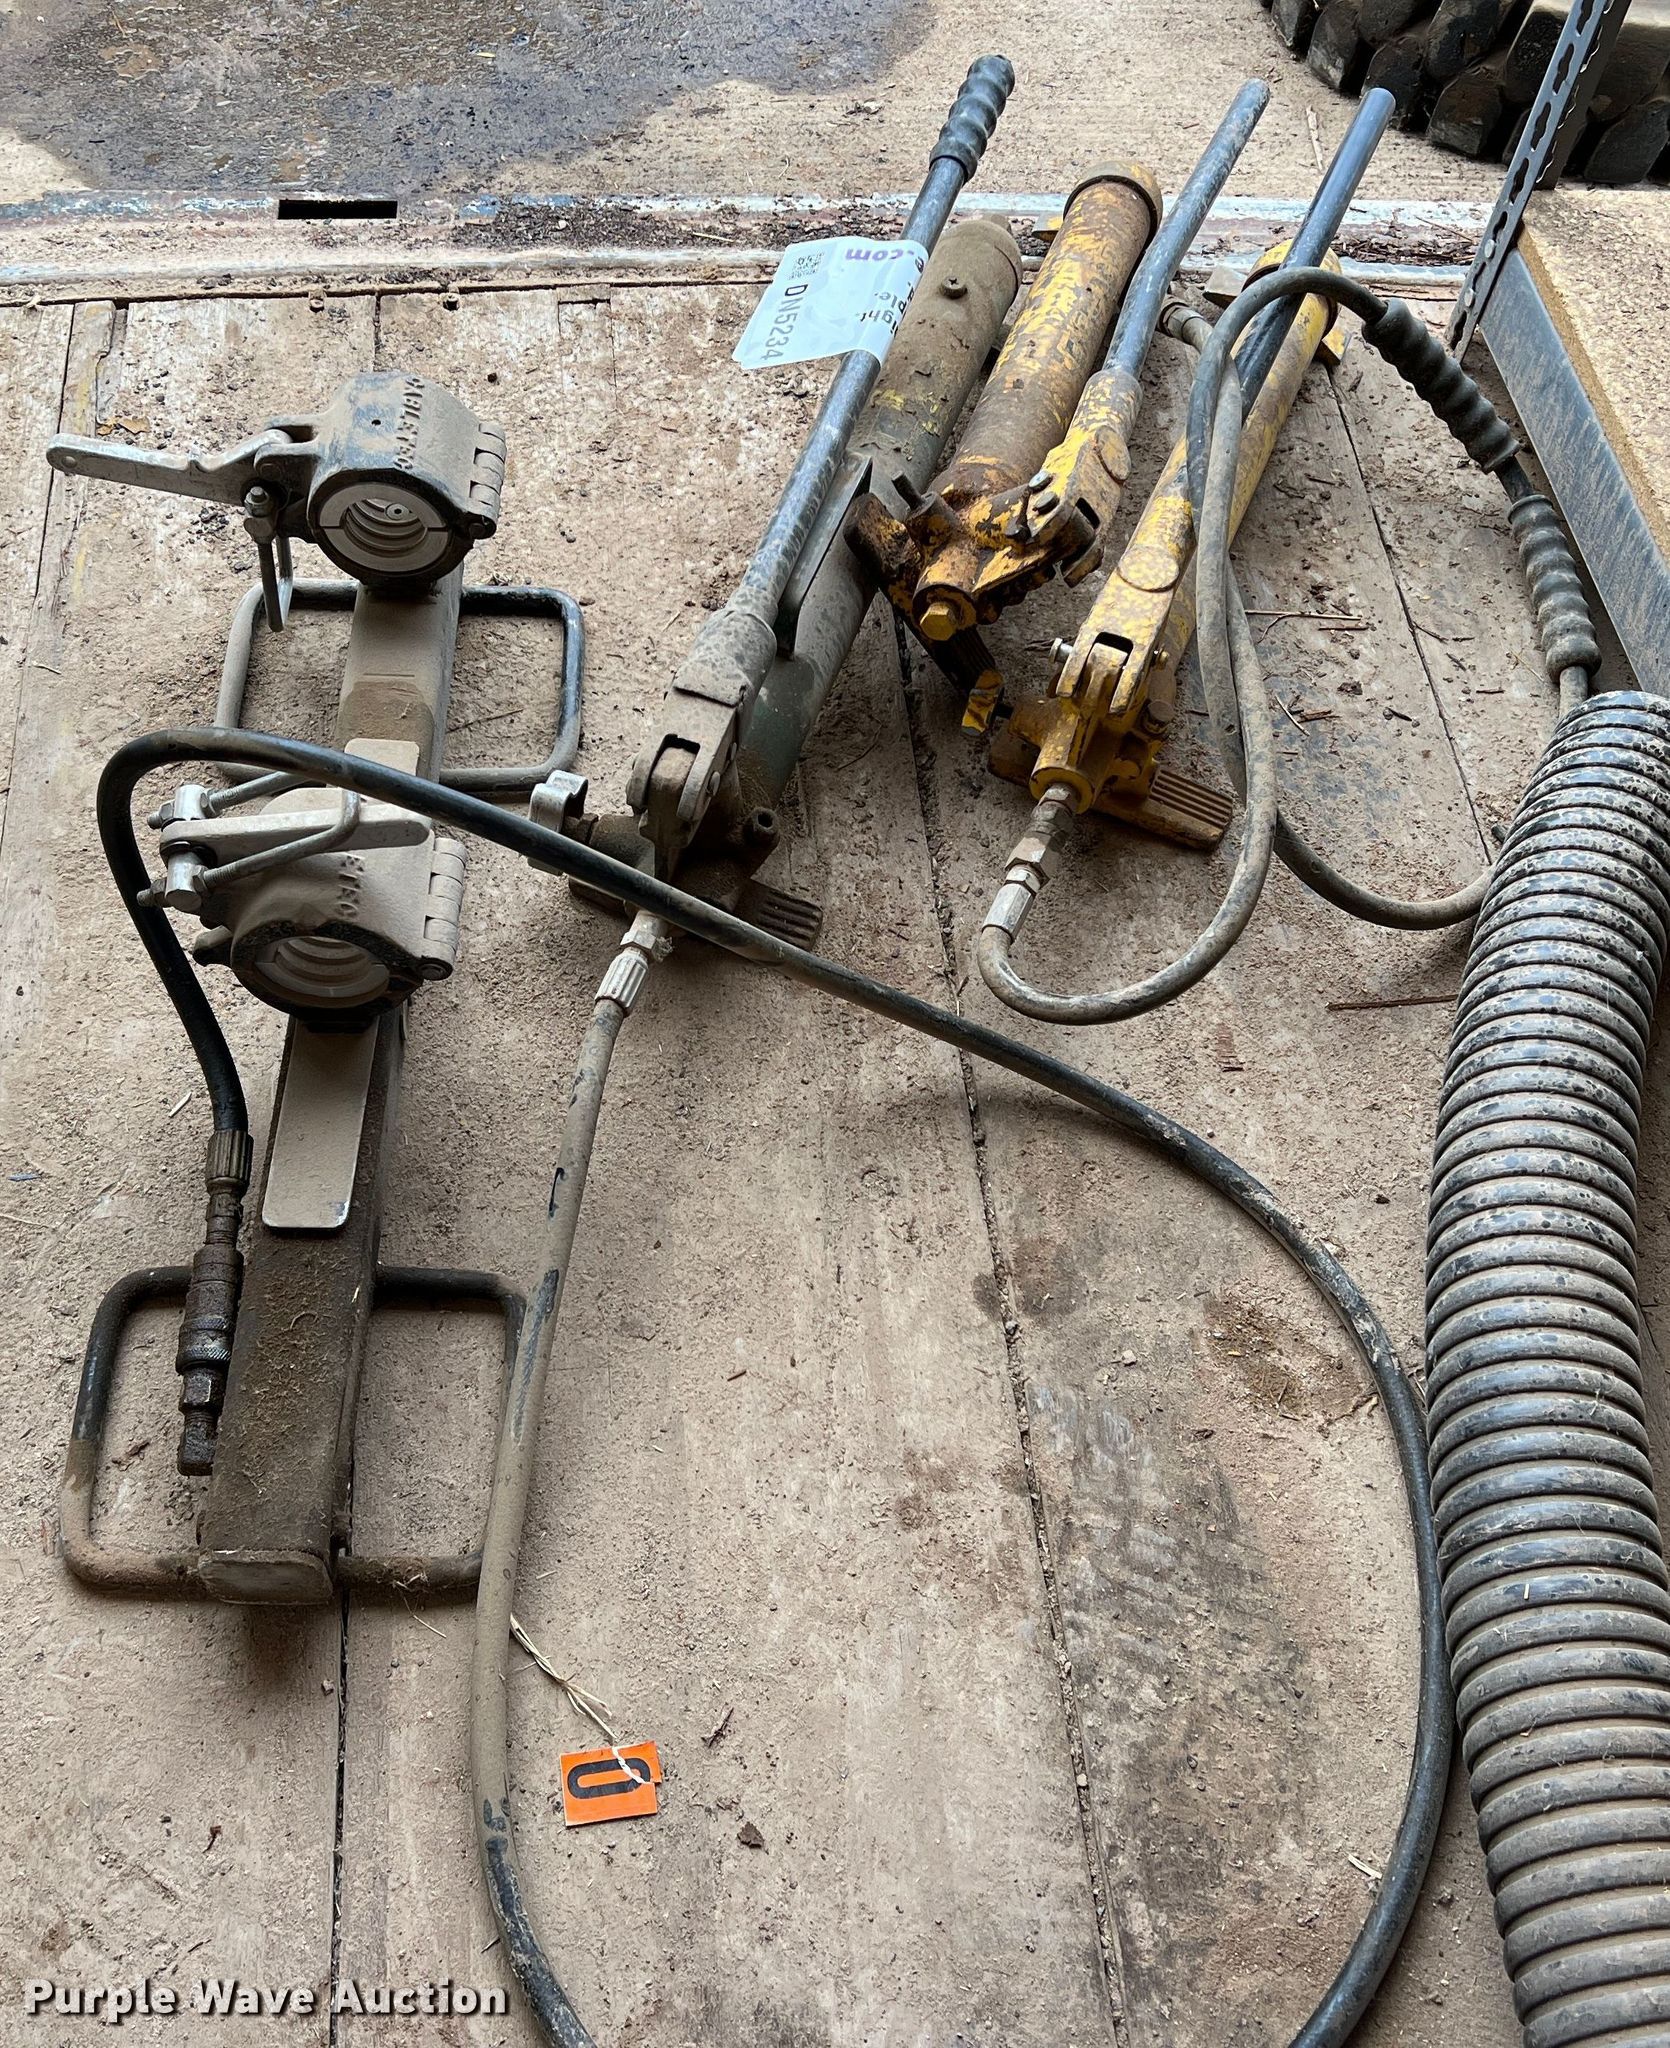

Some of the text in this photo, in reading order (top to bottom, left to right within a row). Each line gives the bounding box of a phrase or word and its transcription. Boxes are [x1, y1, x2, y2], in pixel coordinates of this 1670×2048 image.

[760, 283, 808, 361] DN5234
[874, 291, 908, 315] ple.
[393, 377, 426, 470] CABLETEC
[335, 854, 366, 918] ETEC
